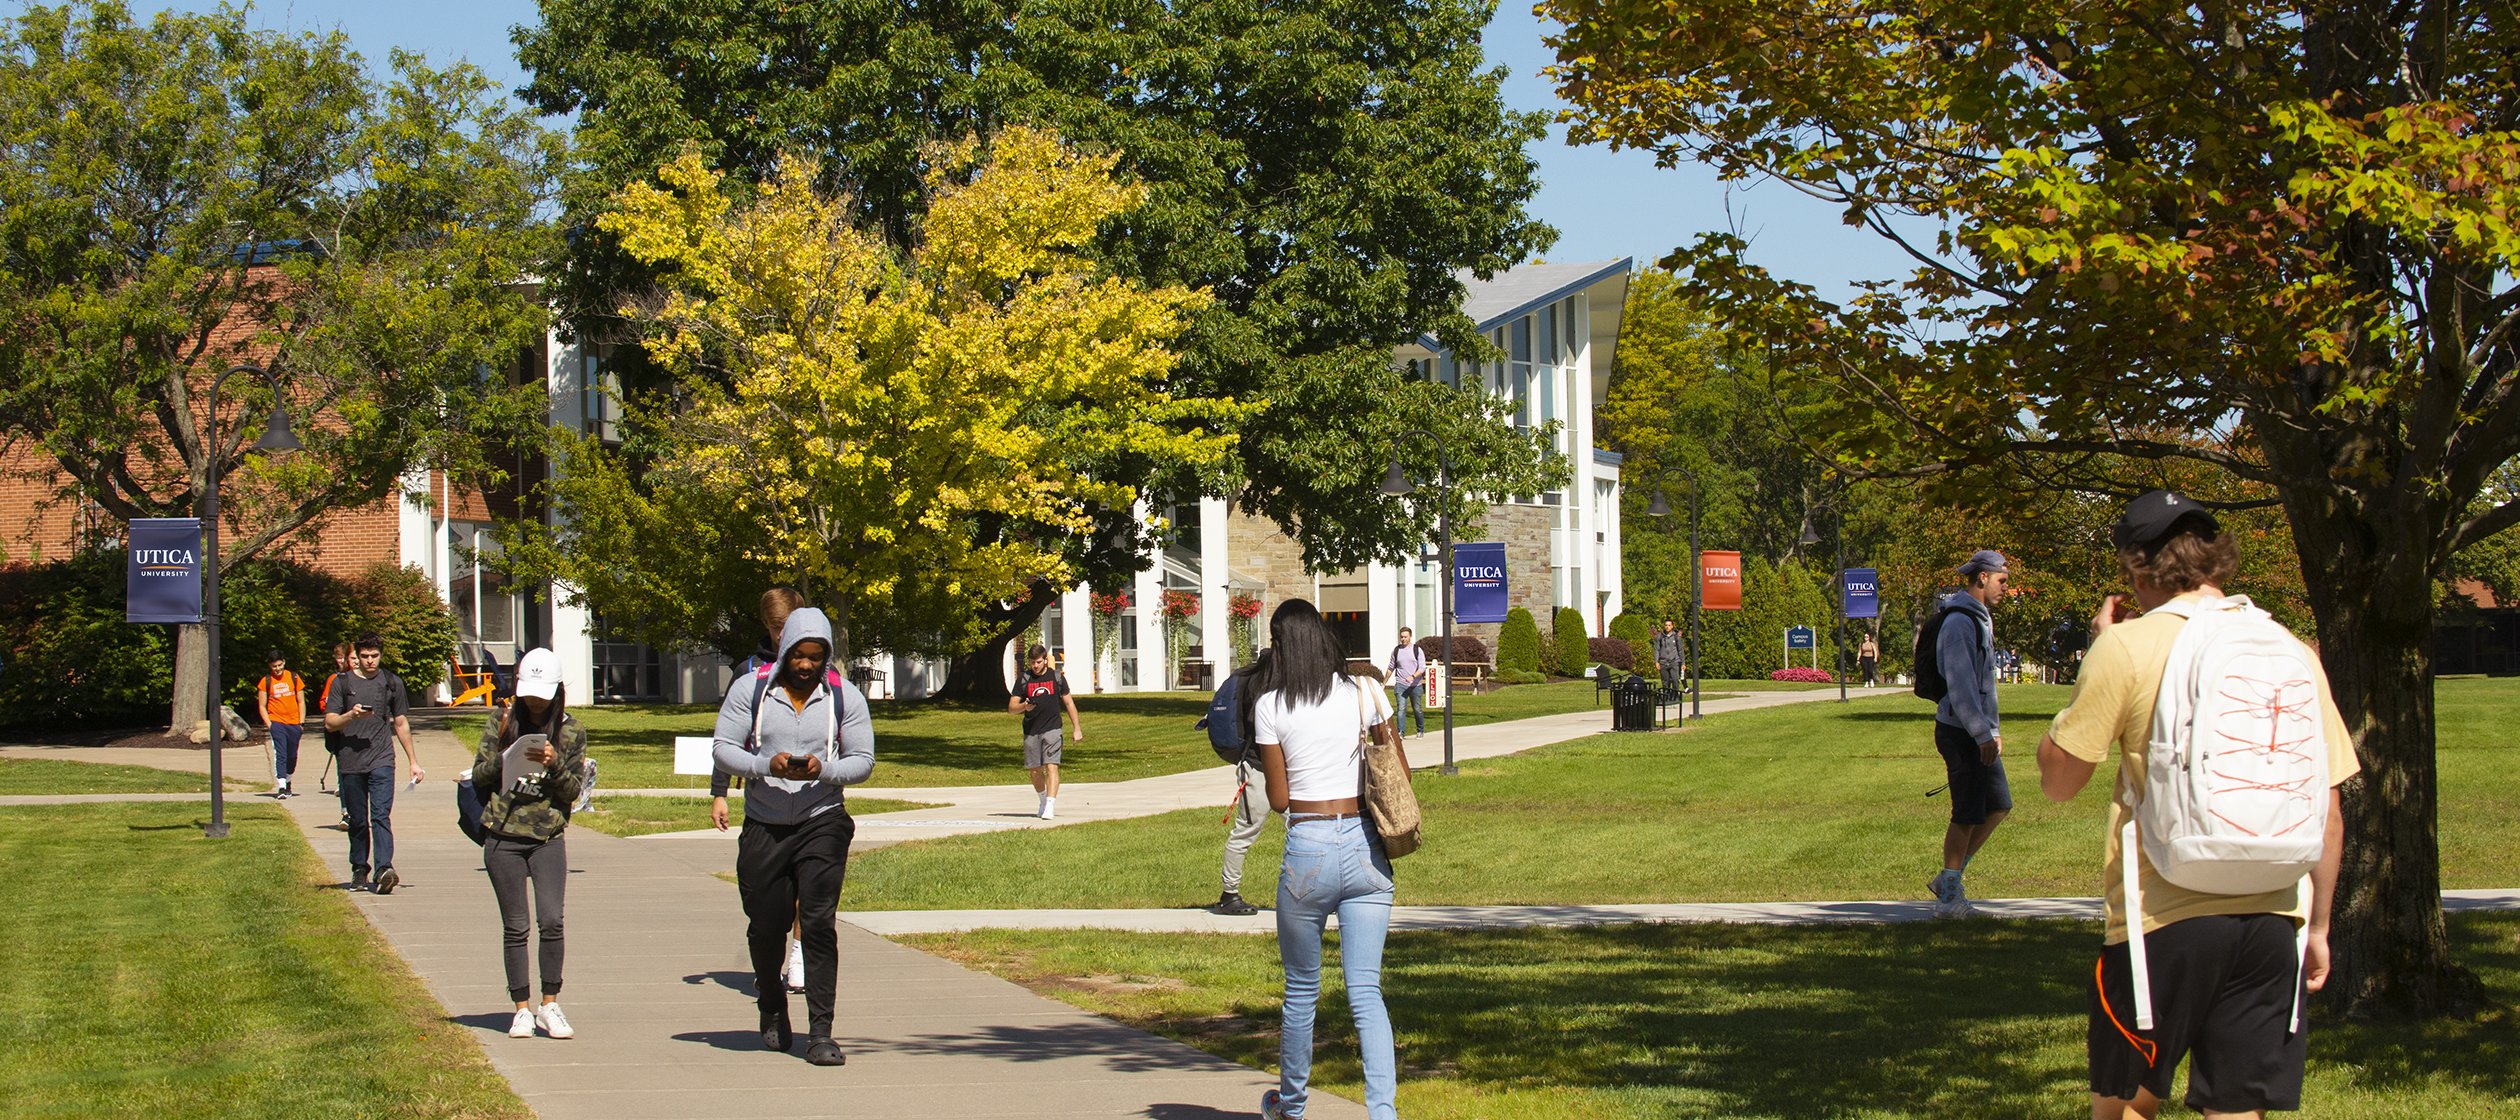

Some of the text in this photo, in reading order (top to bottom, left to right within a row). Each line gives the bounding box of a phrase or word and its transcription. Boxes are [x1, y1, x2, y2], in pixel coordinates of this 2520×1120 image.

[135, 549, 194, 564] UTICA
[1459, 566, 1503, 578] UTICA
[1705, 567, 1738, 577] UTICA
[1848, 582, 1875, 590] UTICA
